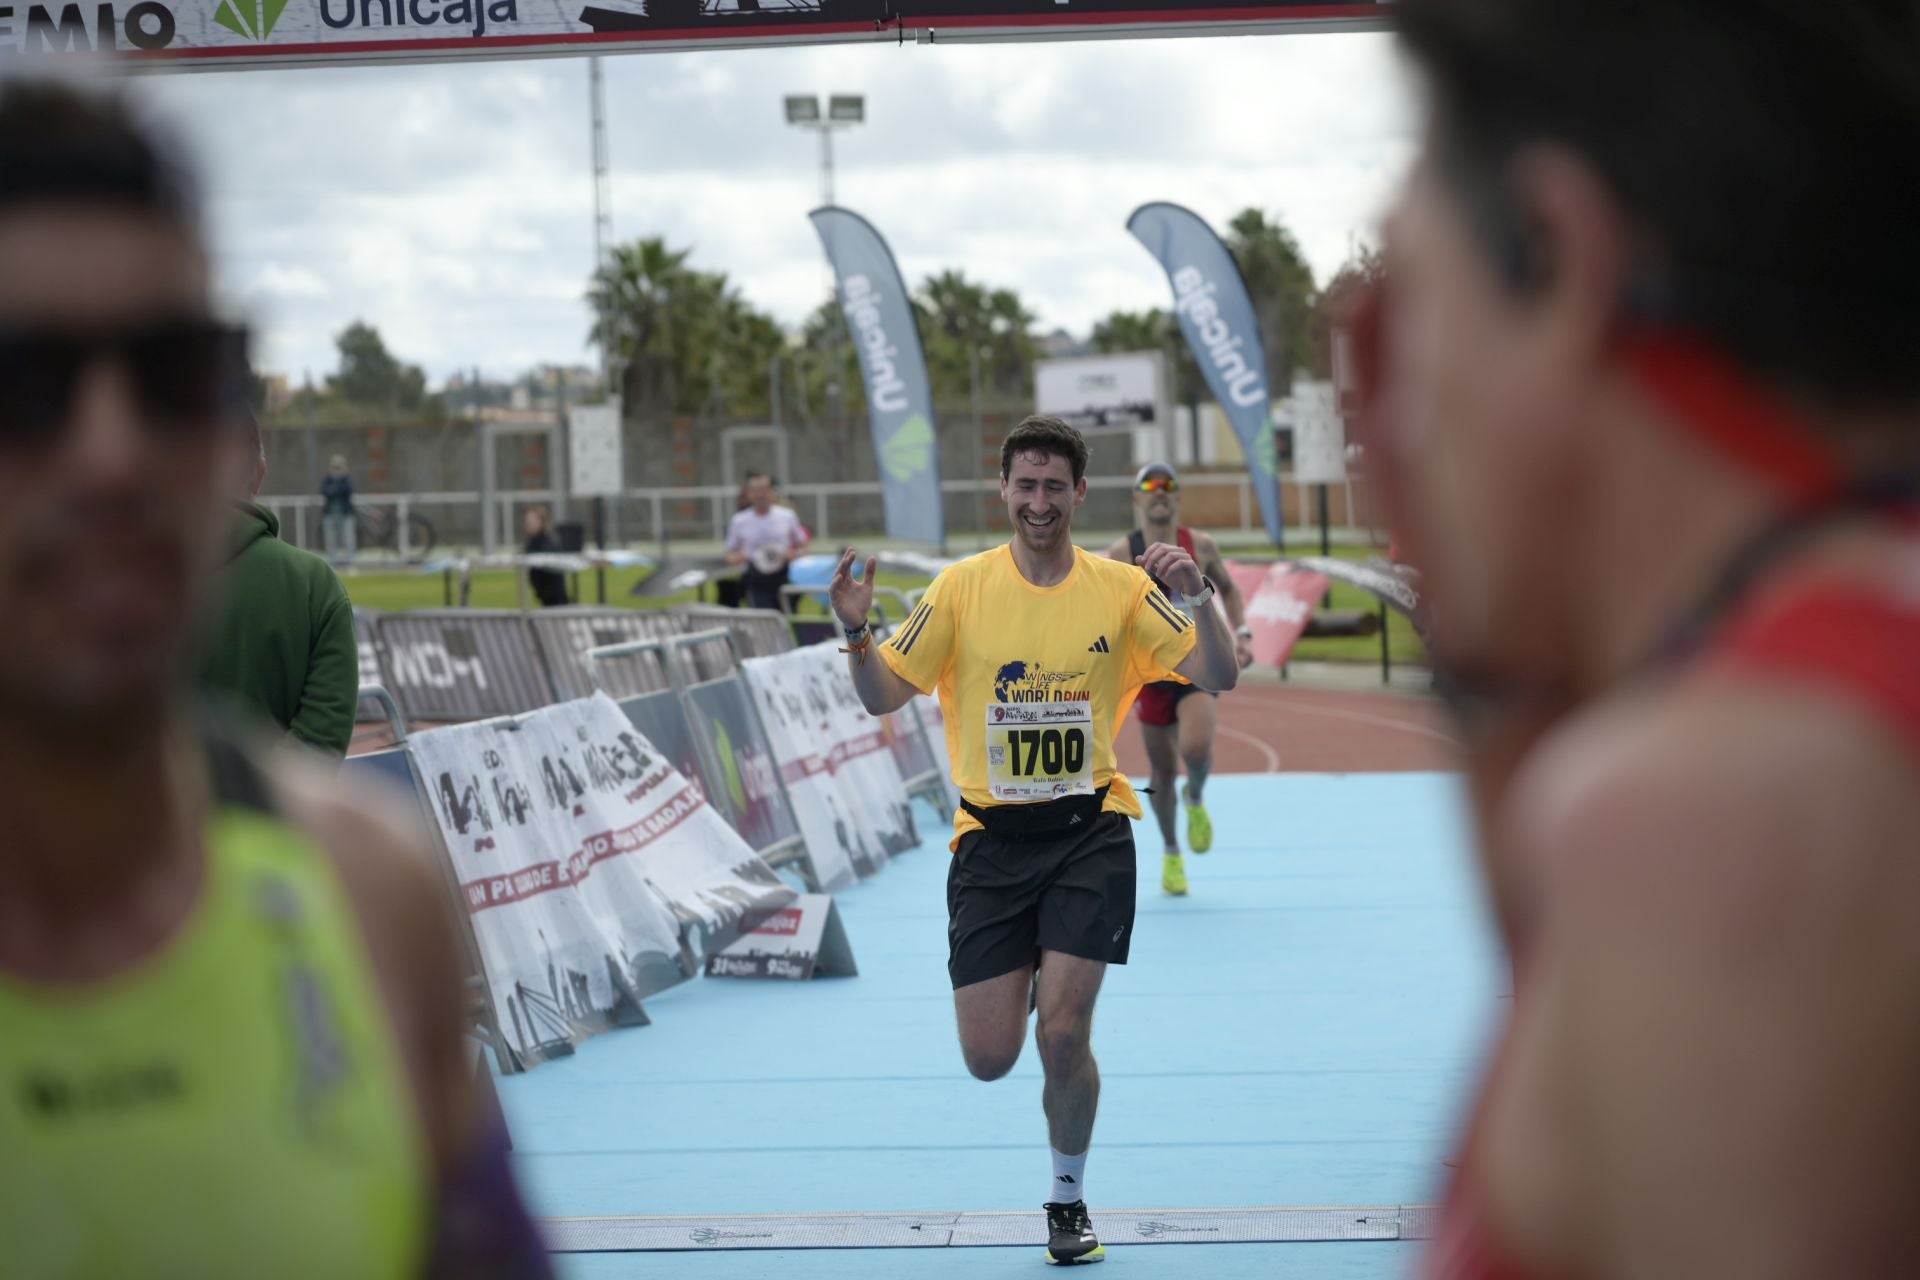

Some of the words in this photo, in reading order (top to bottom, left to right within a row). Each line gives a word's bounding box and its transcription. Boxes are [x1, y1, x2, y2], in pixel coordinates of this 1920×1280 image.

[320, 0, 518, 38] Unicaja
[1025, 671, 1063, 682] WINGS
[1008, 728, 1085, 776] 1700
